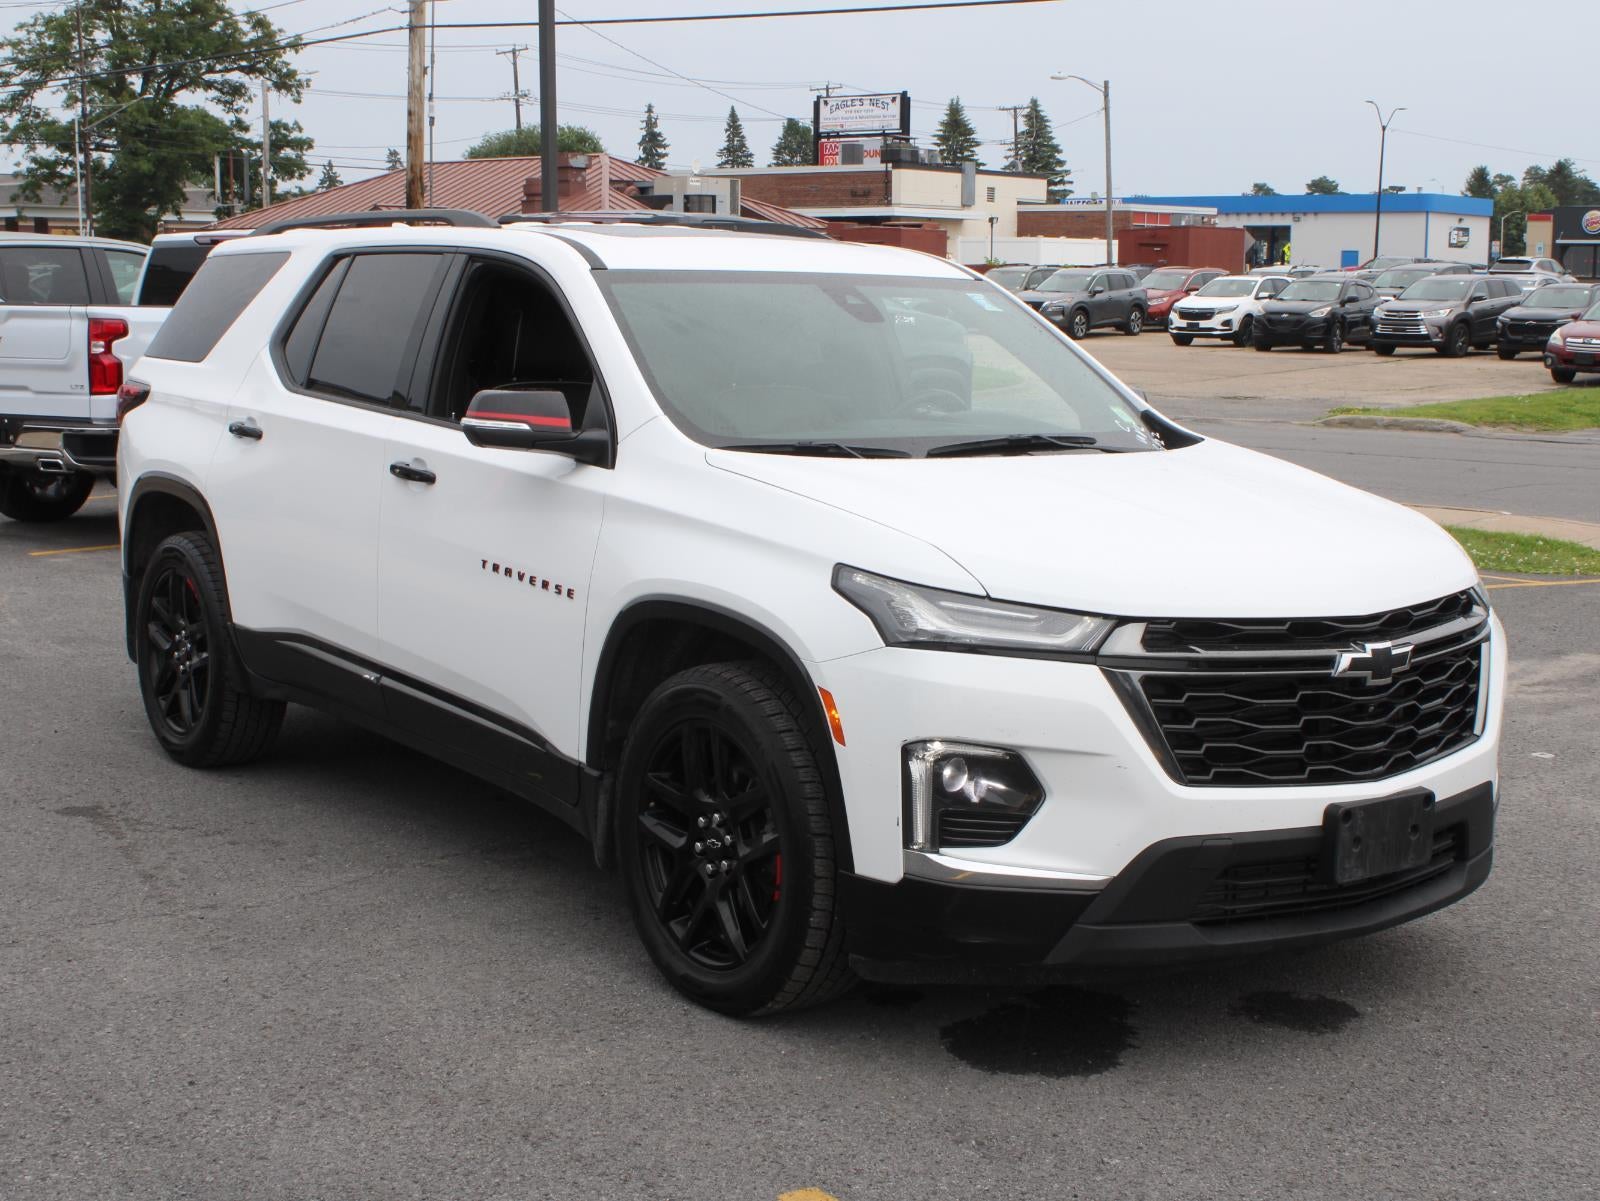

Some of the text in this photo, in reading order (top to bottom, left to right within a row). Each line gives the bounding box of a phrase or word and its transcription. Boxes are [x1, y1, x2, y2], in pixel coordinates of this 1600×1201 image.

[829, 98, 864, 114] EAGLE'S
[869, 98, 890, 111] NEST
[481, 559, 575, 600] TRAVERSE
